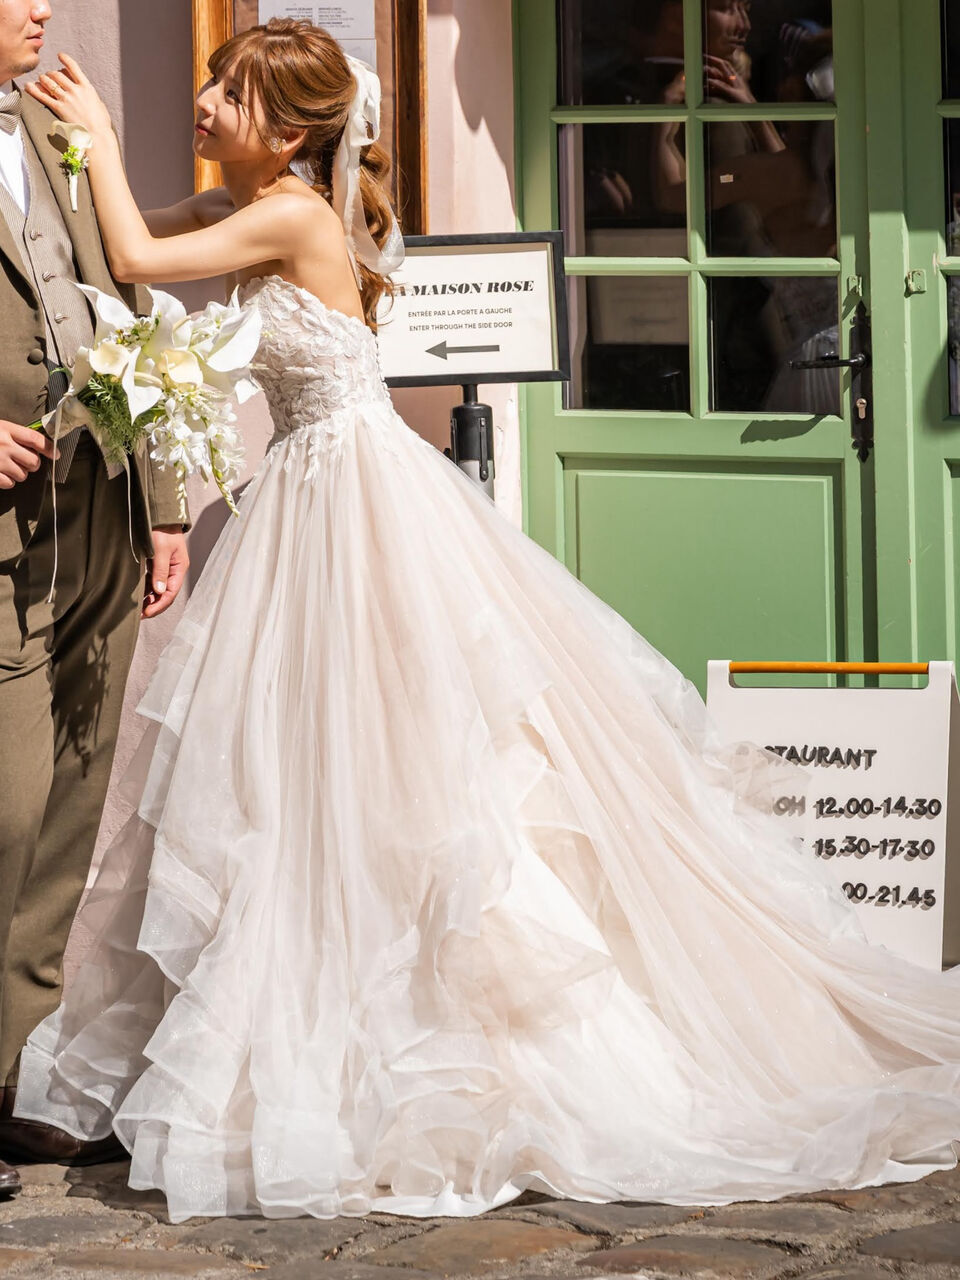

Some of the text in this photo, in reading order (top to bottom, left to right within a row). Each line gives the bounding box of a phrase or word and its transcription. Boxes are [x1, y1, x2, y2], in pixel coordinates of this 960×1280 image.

[411, 282, 483, 296] MAISON
[487, 280, 535, 293] ROSE
[485, 307, 513, 315] GAUCHE
[813, 796, 942, 819] 12.00-14.30
